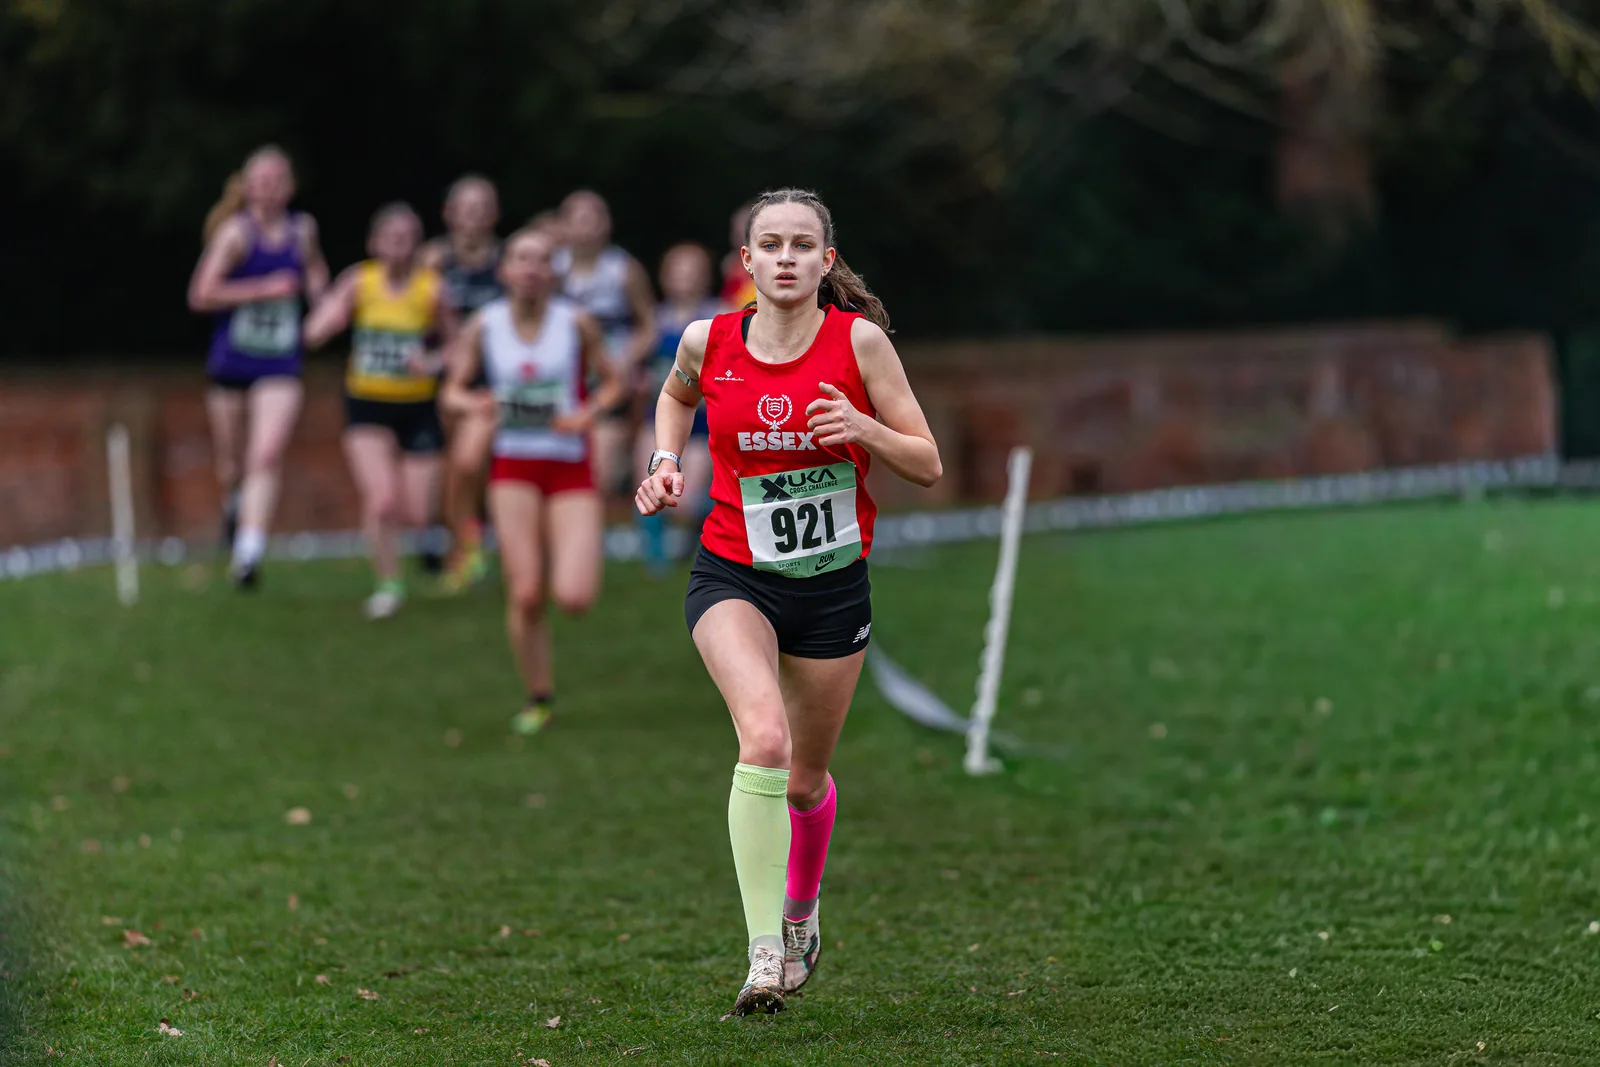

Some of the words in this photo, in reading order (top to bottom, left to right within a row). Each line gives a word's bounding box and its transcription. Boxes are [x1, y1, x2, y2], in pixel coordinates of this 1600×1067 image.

[738, 432, 817, 451] ESSEX
[787, 468, 837, 487] UKA
[789, 486, 808, 495] CROSS
[808, 479, 839, 492] CHALLENGE
[770, 498, 837, 554] 921
[819, 552, 836, 565] RUN
